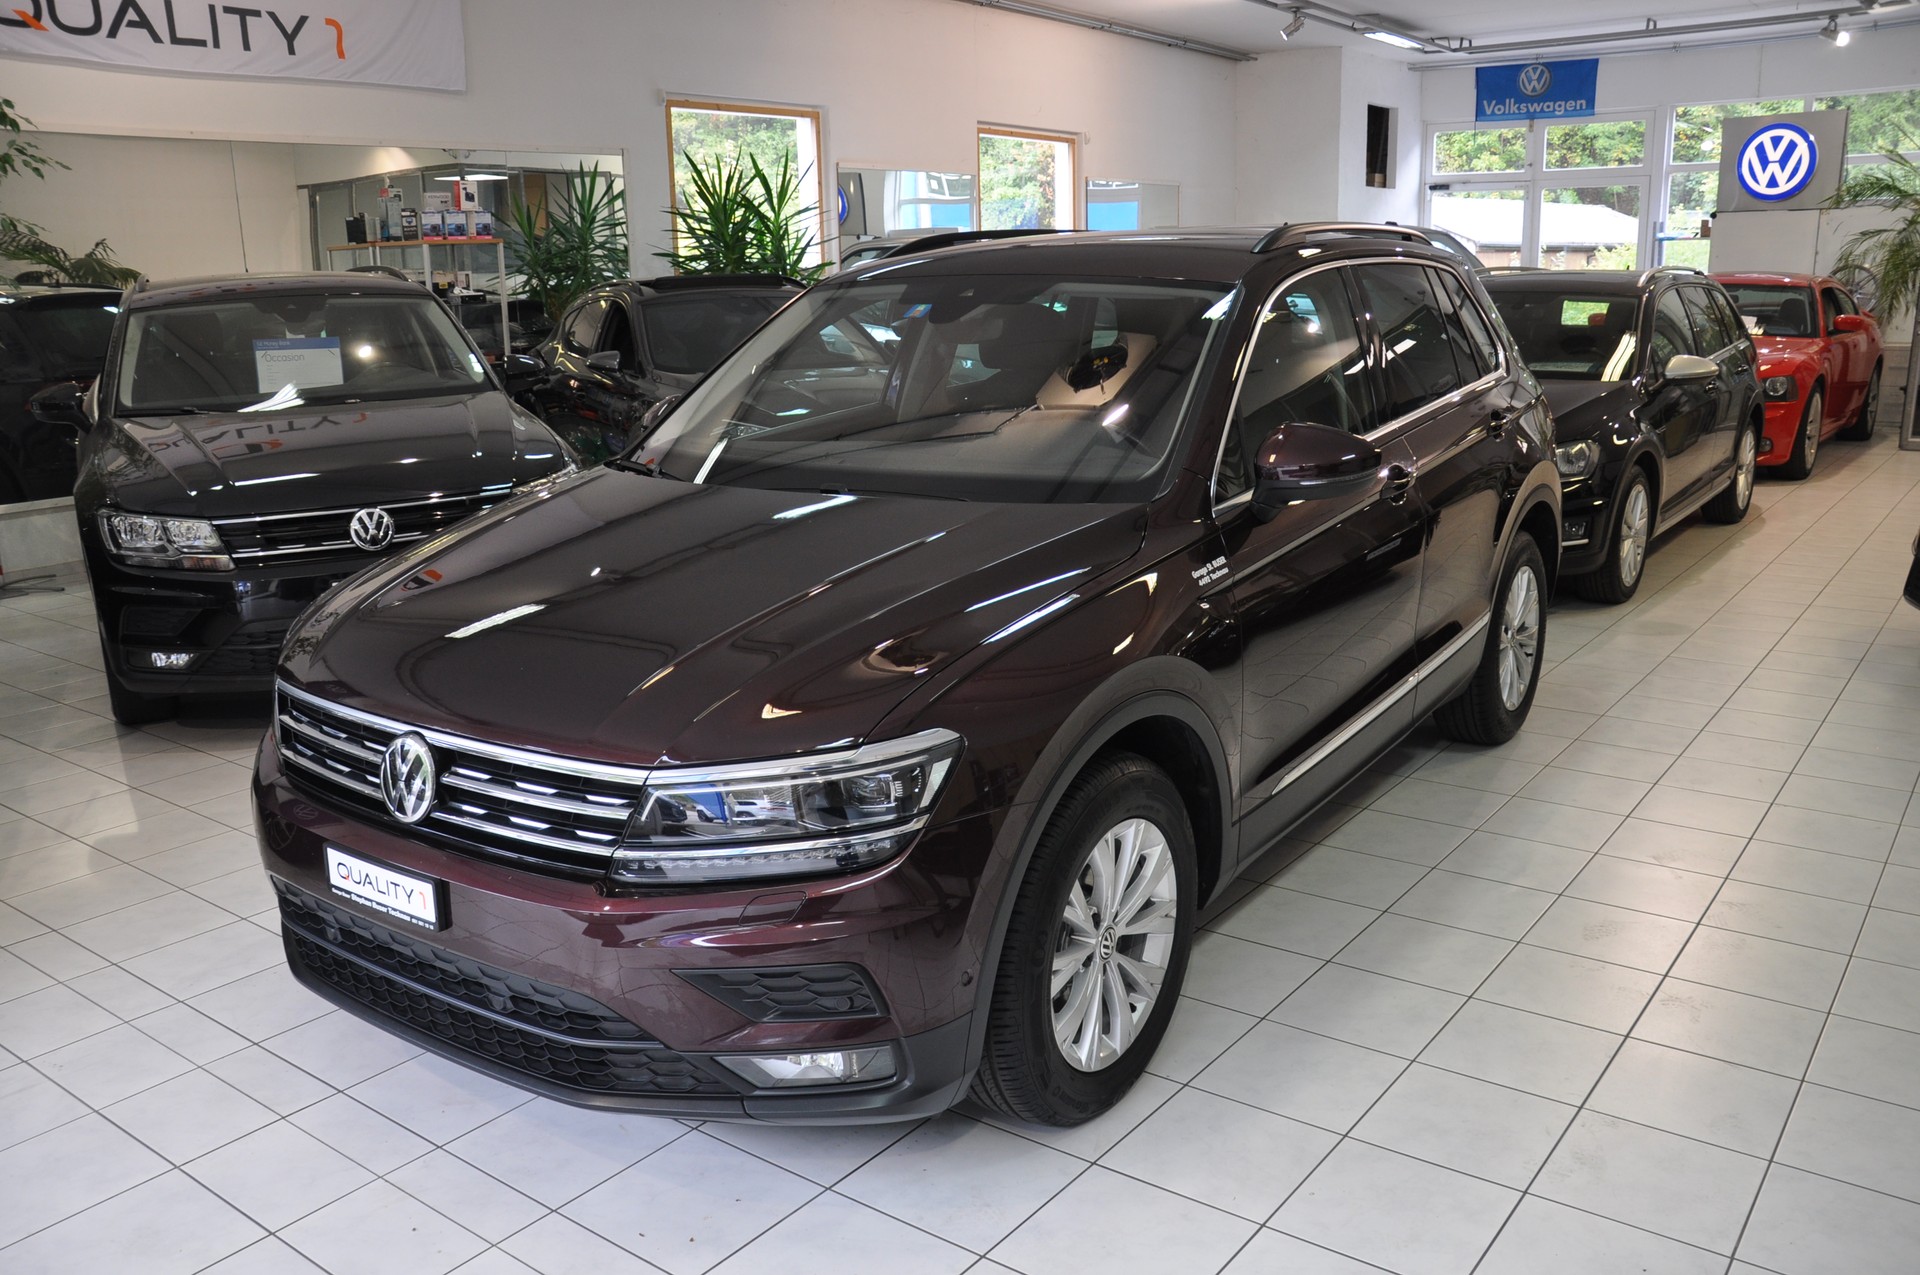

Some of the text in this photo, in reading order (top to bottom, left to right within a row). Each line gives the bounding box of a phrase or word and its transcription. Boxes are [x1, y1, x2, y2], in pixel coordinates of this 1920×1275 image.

[1483, 98, 1587, 115] Volkswagen
[1741, 128, 1810, 196] VW
[264, 353, 305, 363] Occasion
[1192, 567, 1208, 578] Garage
[1212, 556, 1227, 568] BUSER
[336, 861, 414, 905] QUALITY
